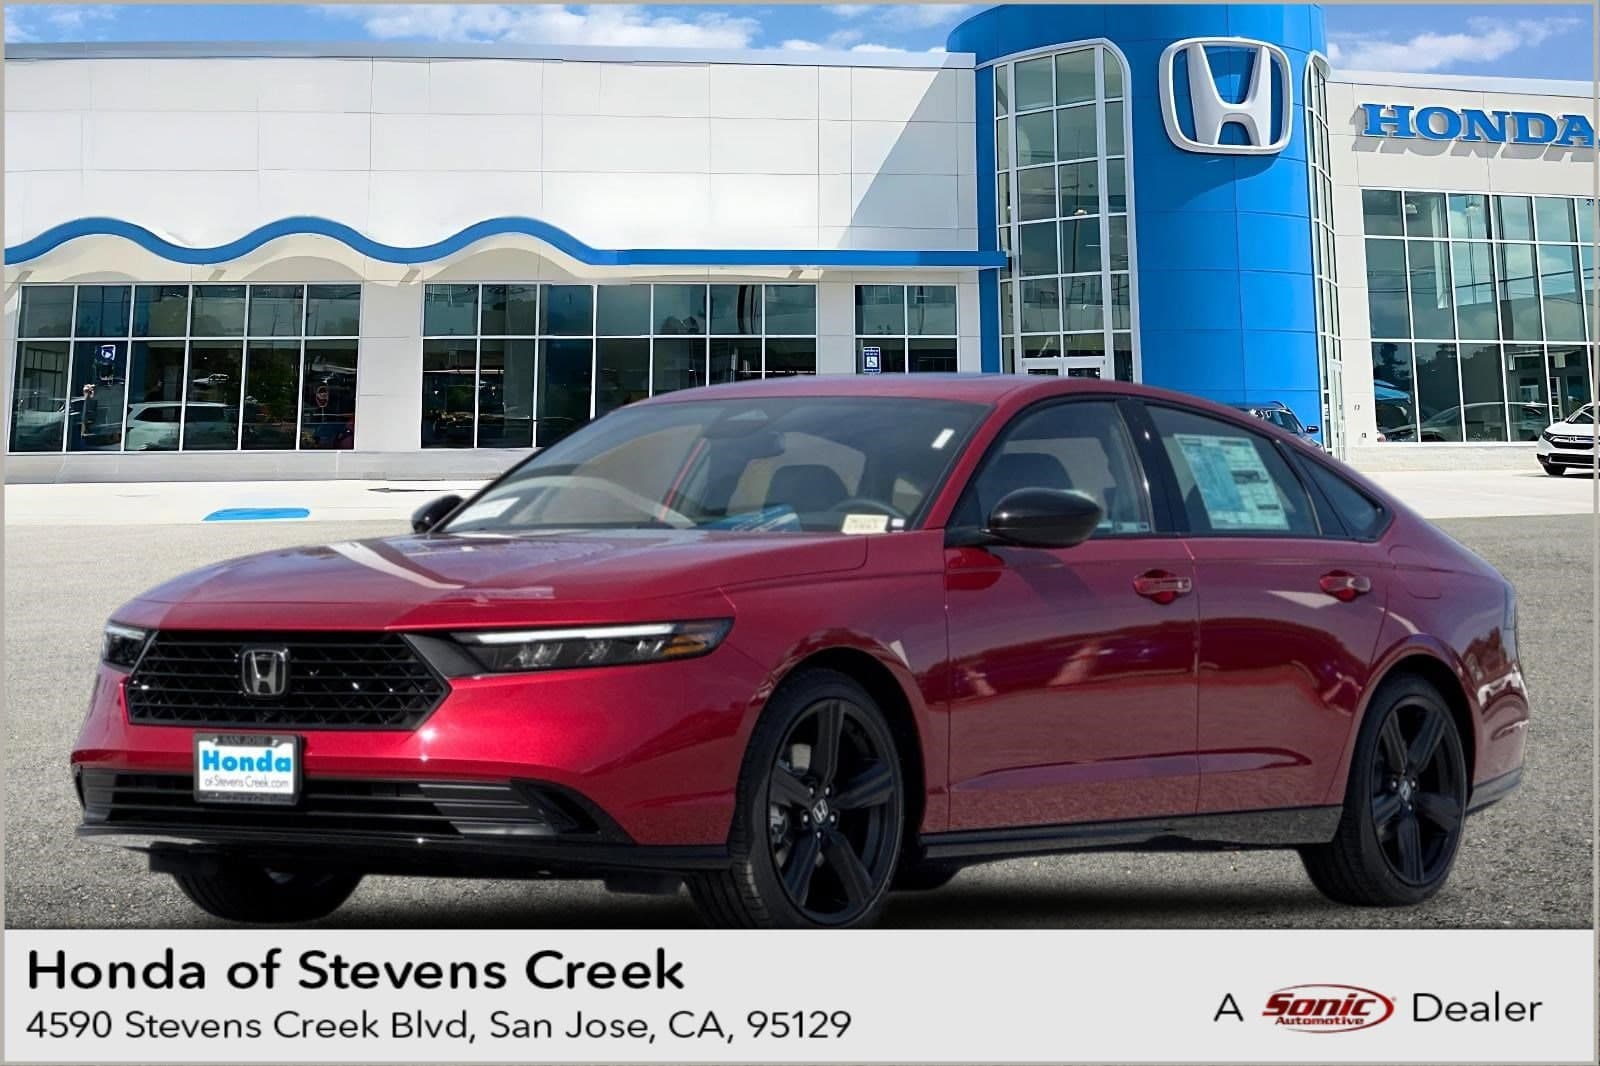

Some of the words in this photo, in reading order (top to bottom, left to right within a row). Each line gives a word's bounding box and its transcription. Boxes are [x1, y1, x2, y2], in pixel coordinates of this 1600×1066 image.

[1361, 103, 1594, 147] HONDA
[202, 749, 292, 772] Honda
[214, 775, 244, 788] Stevens
